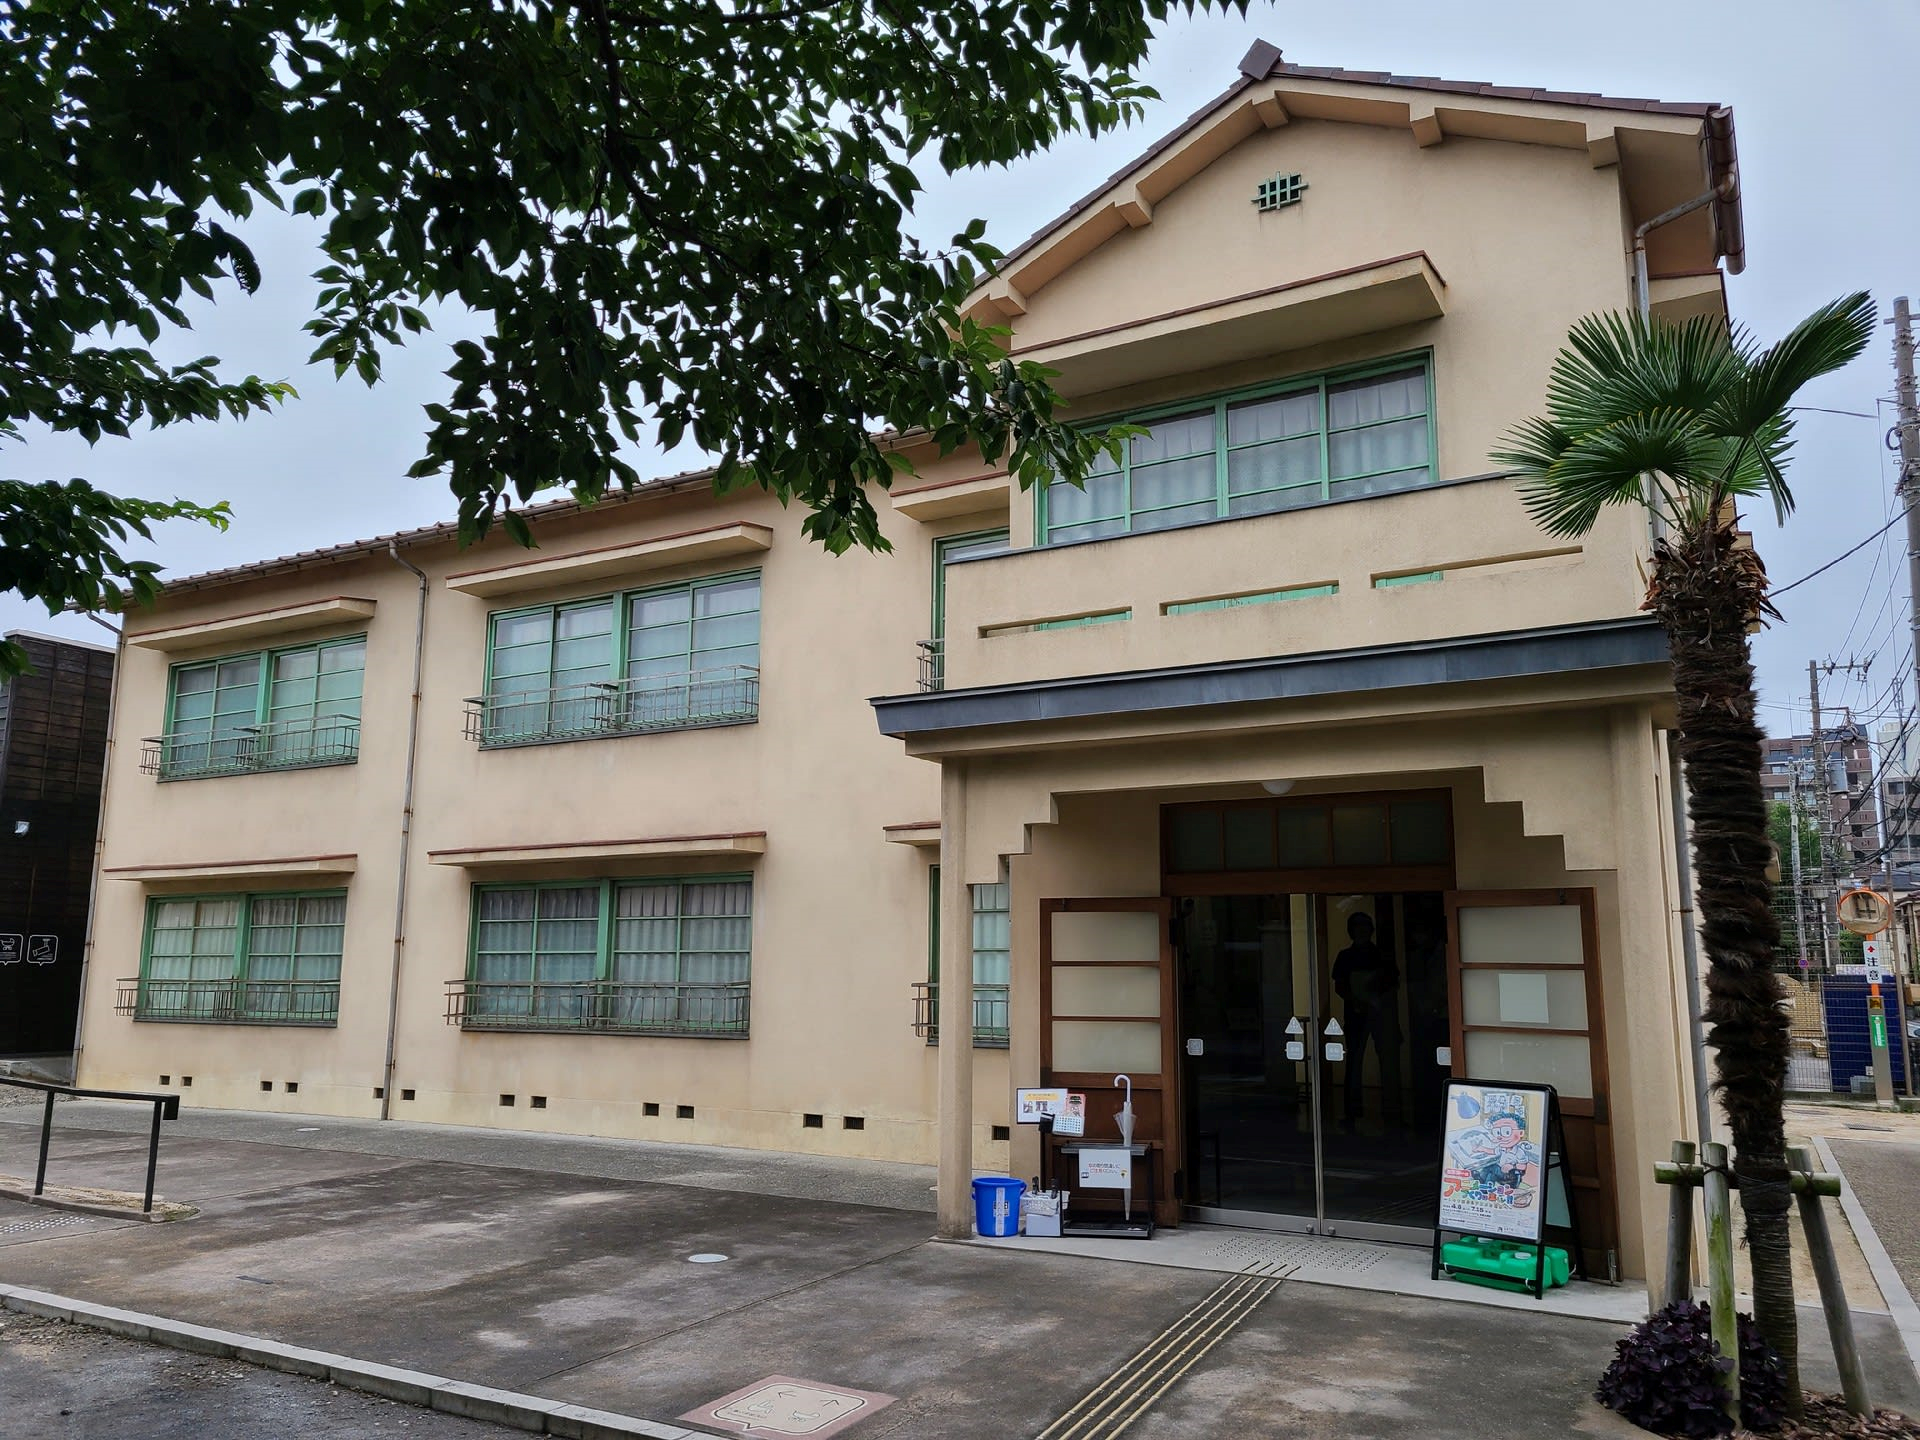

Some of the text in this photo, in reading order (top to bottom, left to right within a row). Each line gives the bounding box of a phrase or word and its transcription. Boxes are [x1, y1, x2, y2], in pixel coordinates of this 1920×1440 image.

[1867, 956, 1880, 981] 注意
[1443, 1177, 1515, 1197] アニメーション
